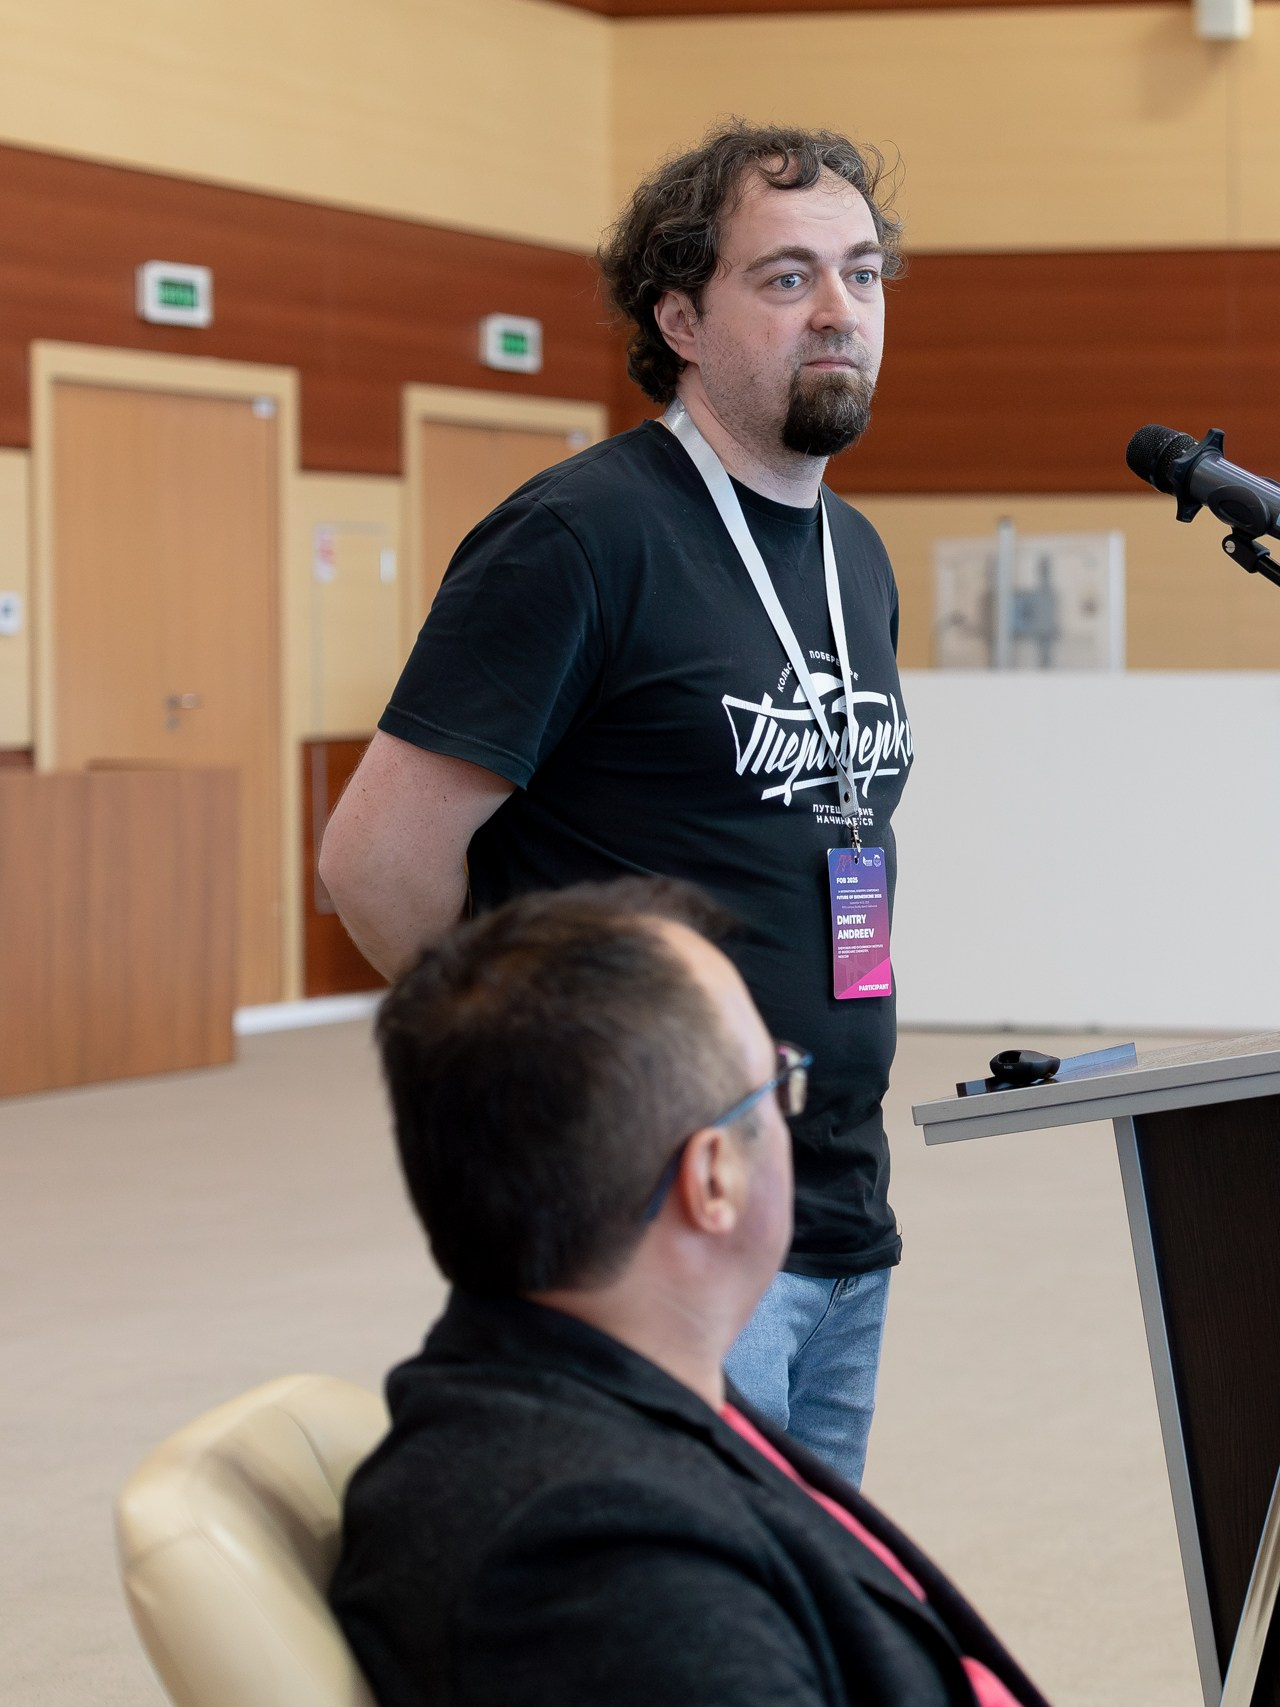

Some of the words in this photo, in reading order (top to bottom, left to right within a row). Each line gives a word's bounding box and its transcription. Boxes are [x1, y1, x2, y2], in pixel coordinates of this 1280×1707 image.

[808, 650, 859, 681] ПОБЕРЕЬЕ
[812, 804, 874, 816] ПУТЕШВИЕ
[836, 914, 866, 925] DMITRY
[838, 928, 874, 939] ANDREEV
